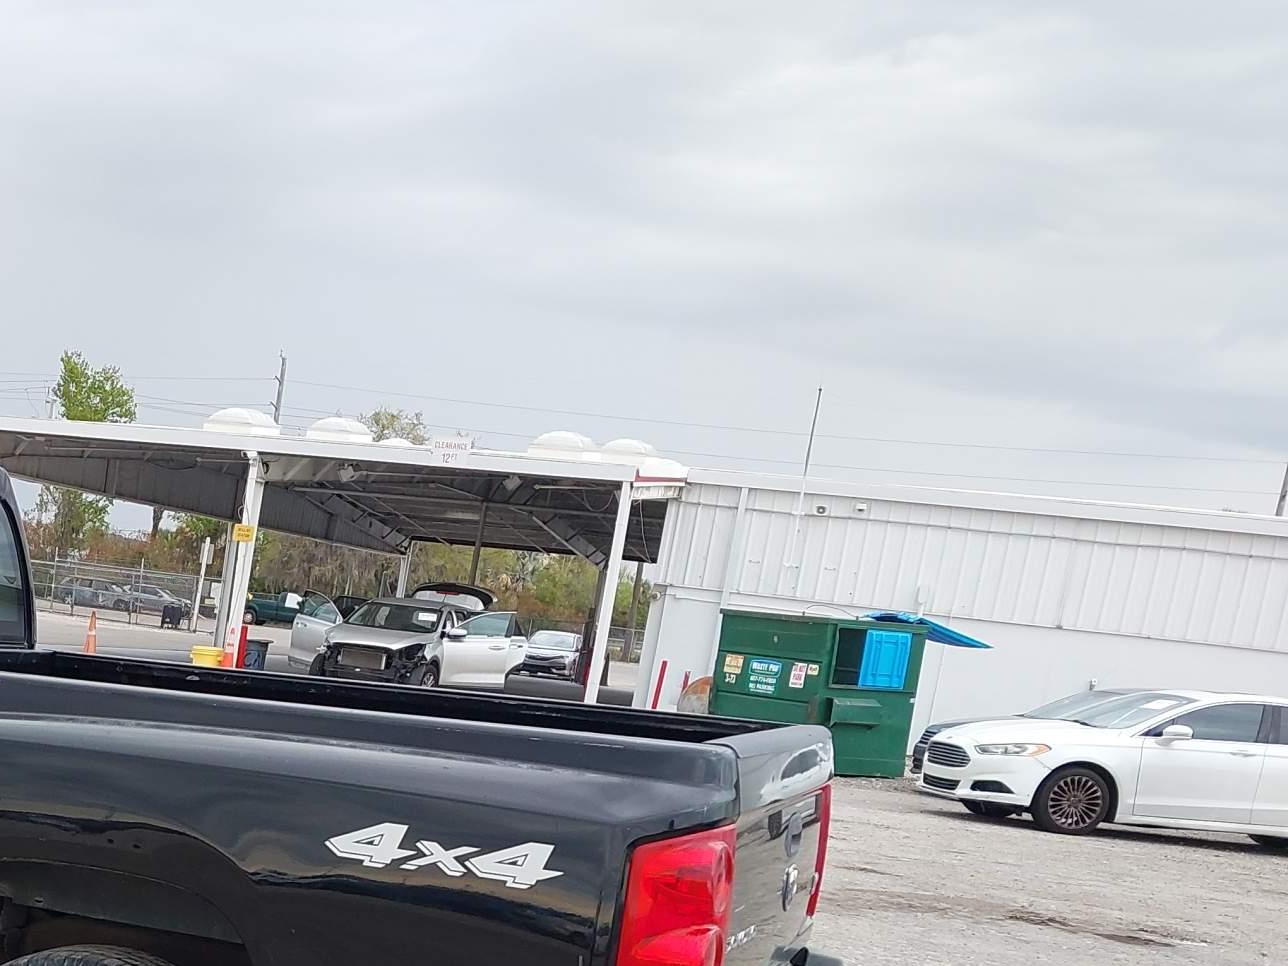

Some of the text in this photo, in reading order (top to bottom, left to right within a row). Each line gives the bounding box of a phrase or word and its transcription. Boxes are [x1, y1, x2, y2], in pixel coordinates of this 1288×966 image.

[434, 440, 468, 450] CLEARANCE
[441, 452, 450, 463] 12
[324, 822, 565, 889] 4x4
